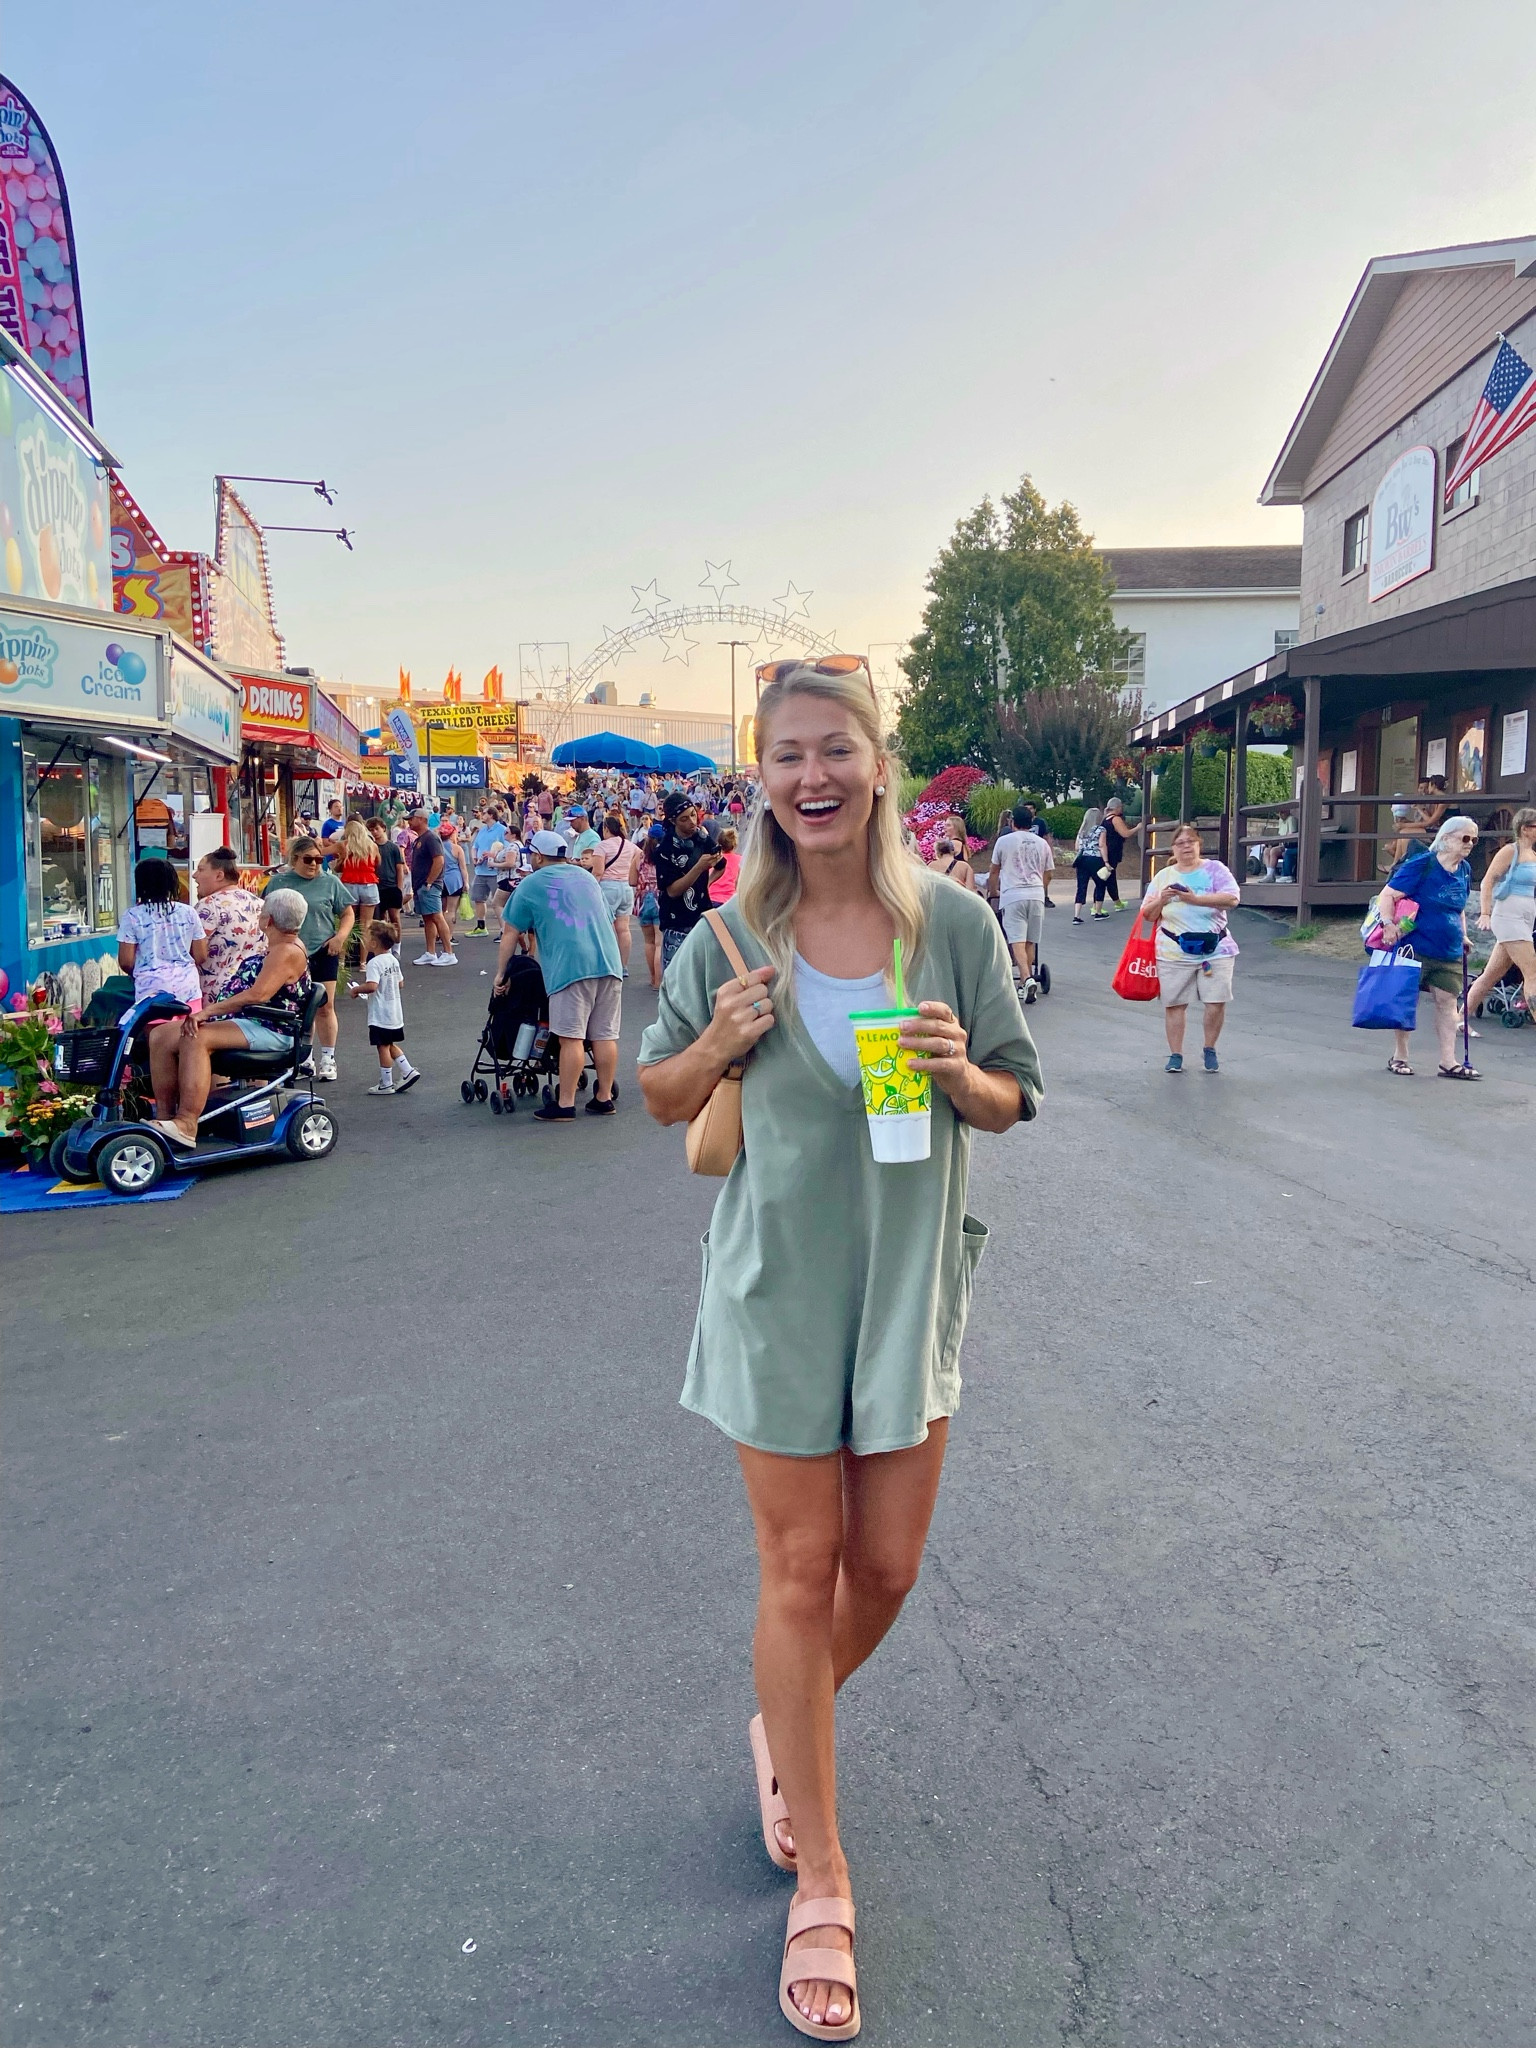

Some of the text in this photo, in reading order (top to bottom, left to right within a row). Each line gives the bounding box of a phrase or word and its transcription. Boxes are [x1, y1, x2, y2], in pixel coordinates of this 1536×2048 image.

[60, 541, 81, 580] dots
[18, 661, 45, 677] dots
[99, 661, 124, 682] Ice
[81, 675, 141, 701] Cream
[249, 685, 304, 720] DRINKS
[421, 706, 482, 717] TEXAS TOAST
[476, 714, 516, 727] CHEESE
[395, 773, 480, 785] REOOMS
[99, 877, 114, 913] 413
[1128, 957, 1158, 979] dish
